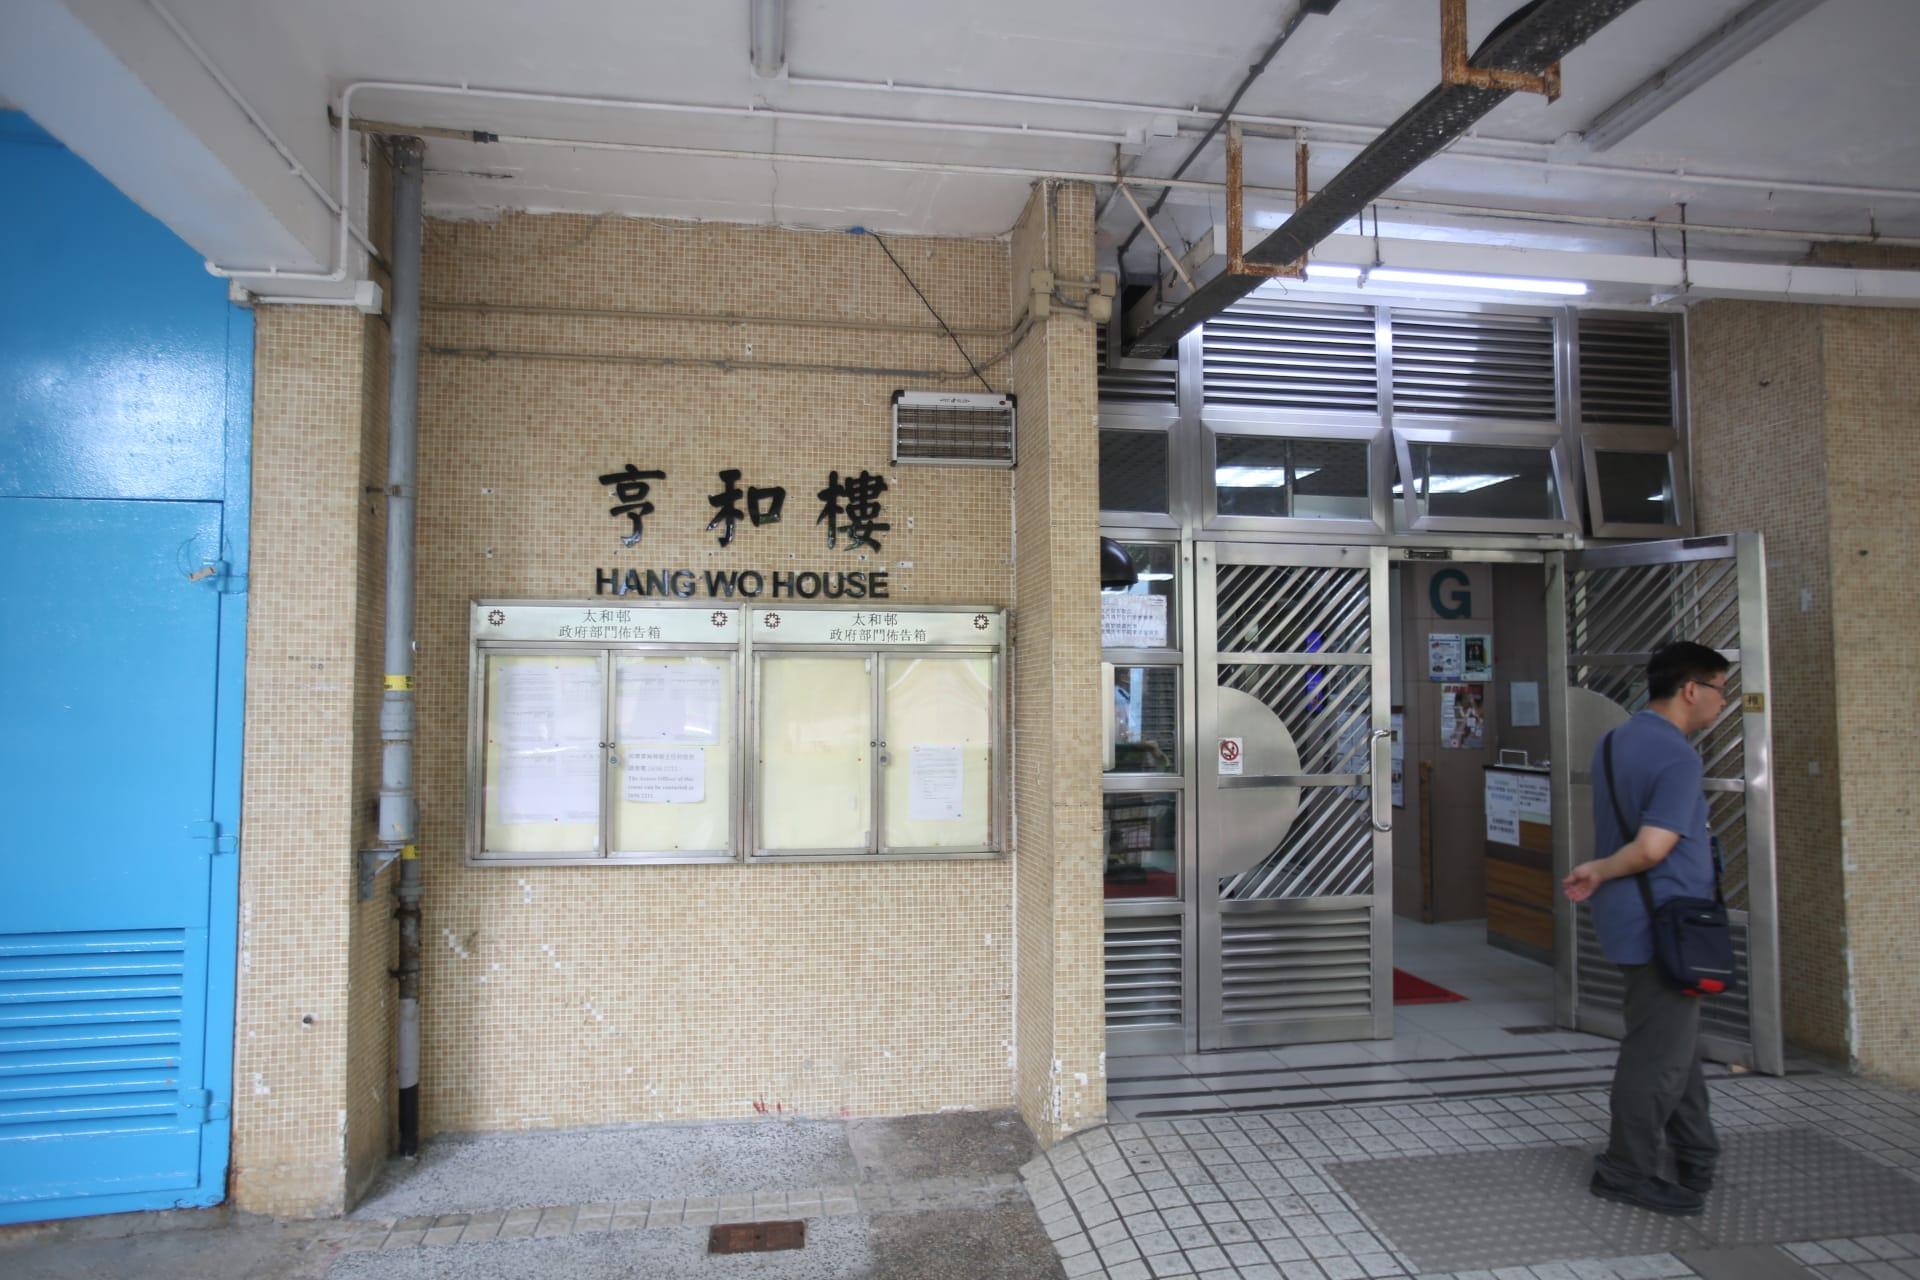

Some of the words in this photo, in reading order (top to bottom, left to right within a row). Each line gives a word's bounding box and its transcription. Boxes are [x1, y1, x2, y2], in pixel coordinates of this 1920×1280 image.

[599, 464, 891, 552] 亨和樓
[595, 567, 696, 597] HANG
[704, 570, 763, 598] WO
[772, 571, 889, 598] HOUSE
[1429, 568, 1471, 619] G
[583, 609, 632, 623] 太和邨
[852, 613, 898, 627] 太和邨
[558, 625, 662, 640] 政府部門佈告箱
[829, 628, 927, 643] 政府部門佈告箱
